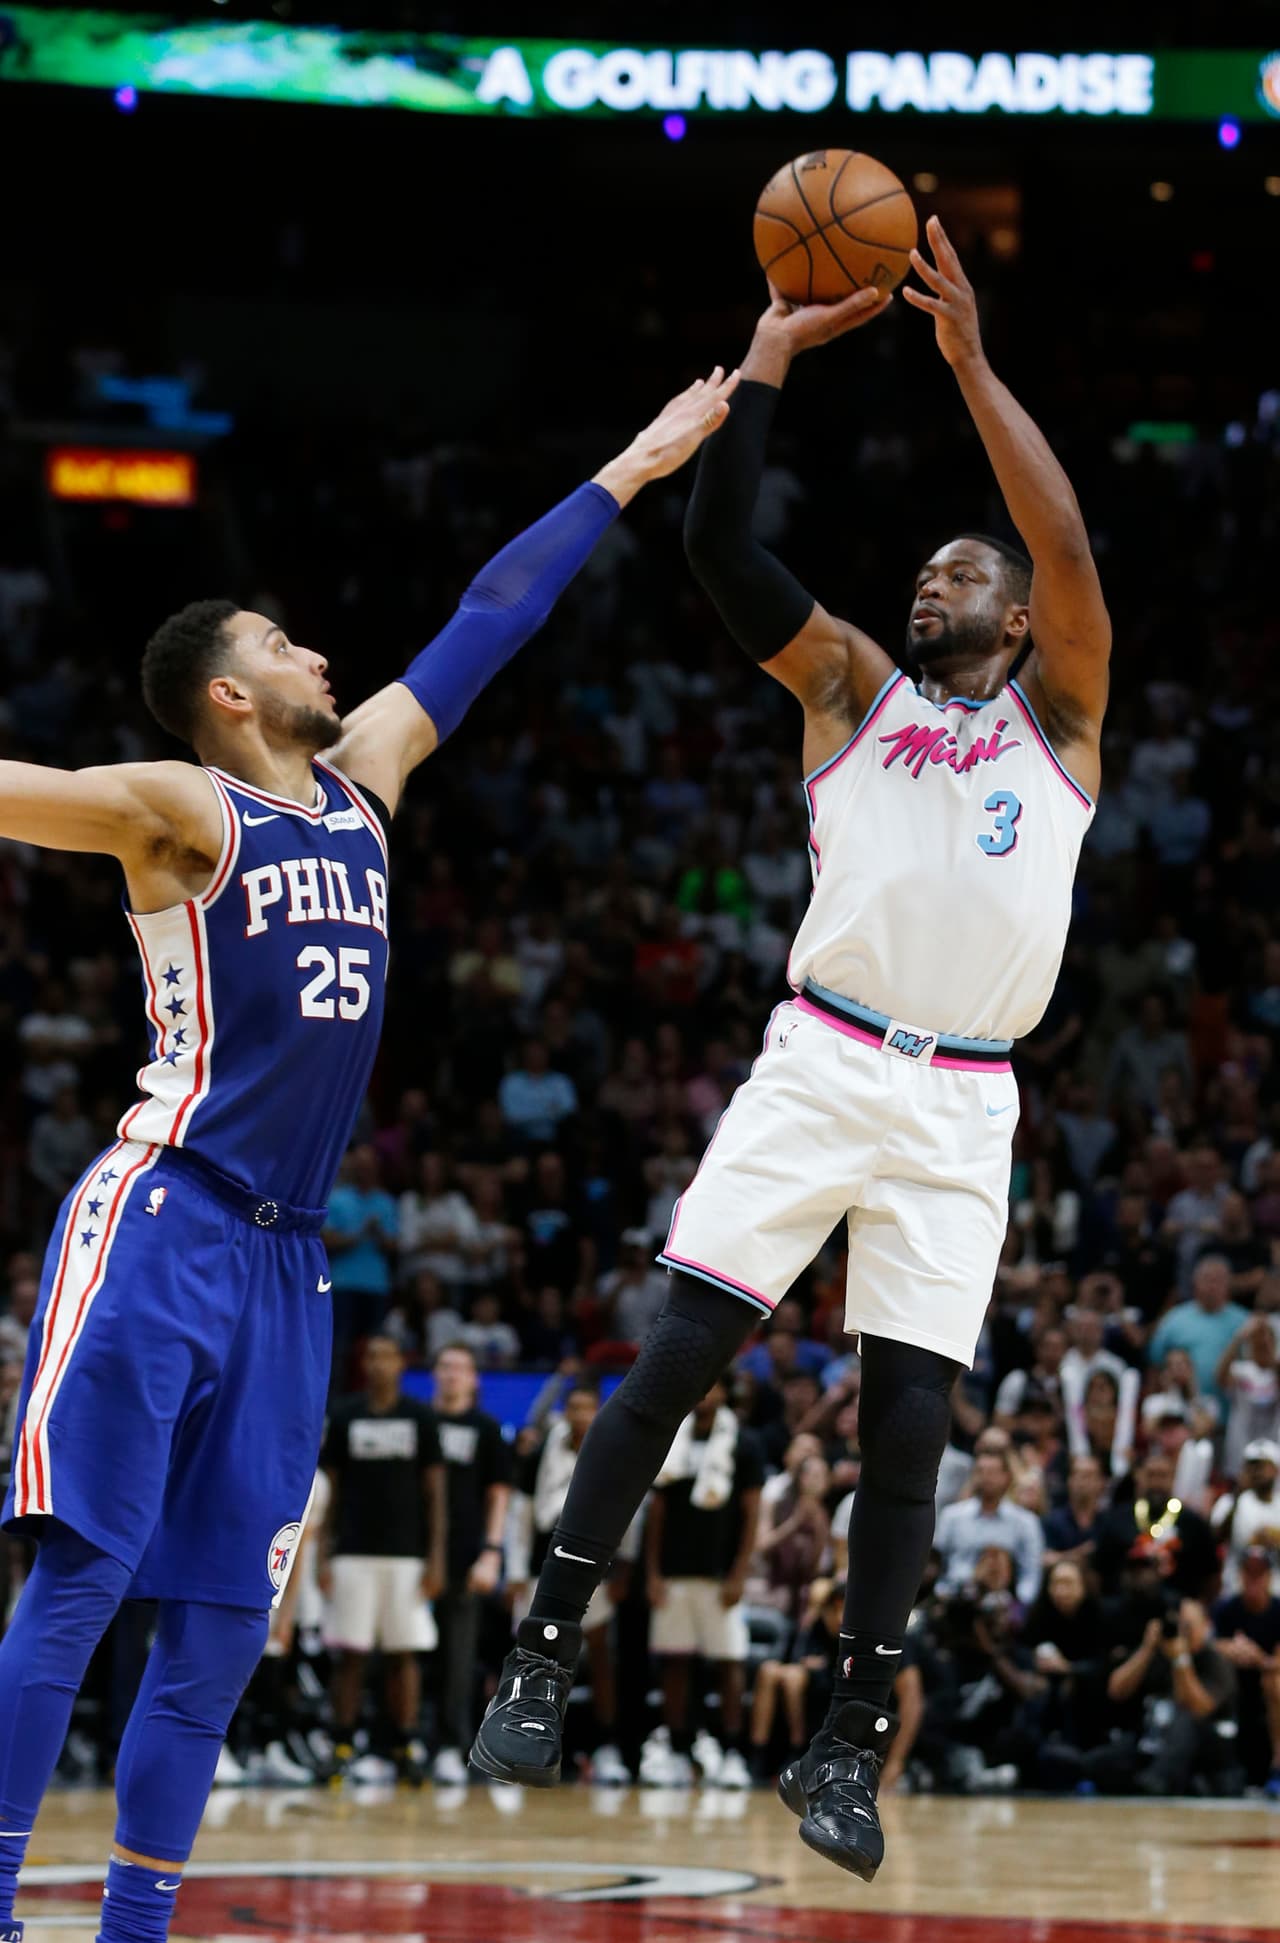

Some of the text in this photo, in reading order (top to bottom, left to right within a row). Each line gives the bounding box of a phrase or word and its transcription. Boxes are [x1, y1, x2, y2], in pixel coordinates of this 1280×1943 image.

[476, 46, 1154, 114] A GOLFING PARADISE
[879, 719, 1022, 779] Miami
[976, 790, 1023, 857] 3
[297, 945, 371, 1020] 25
[272, 1547, 290, 1571] 76
